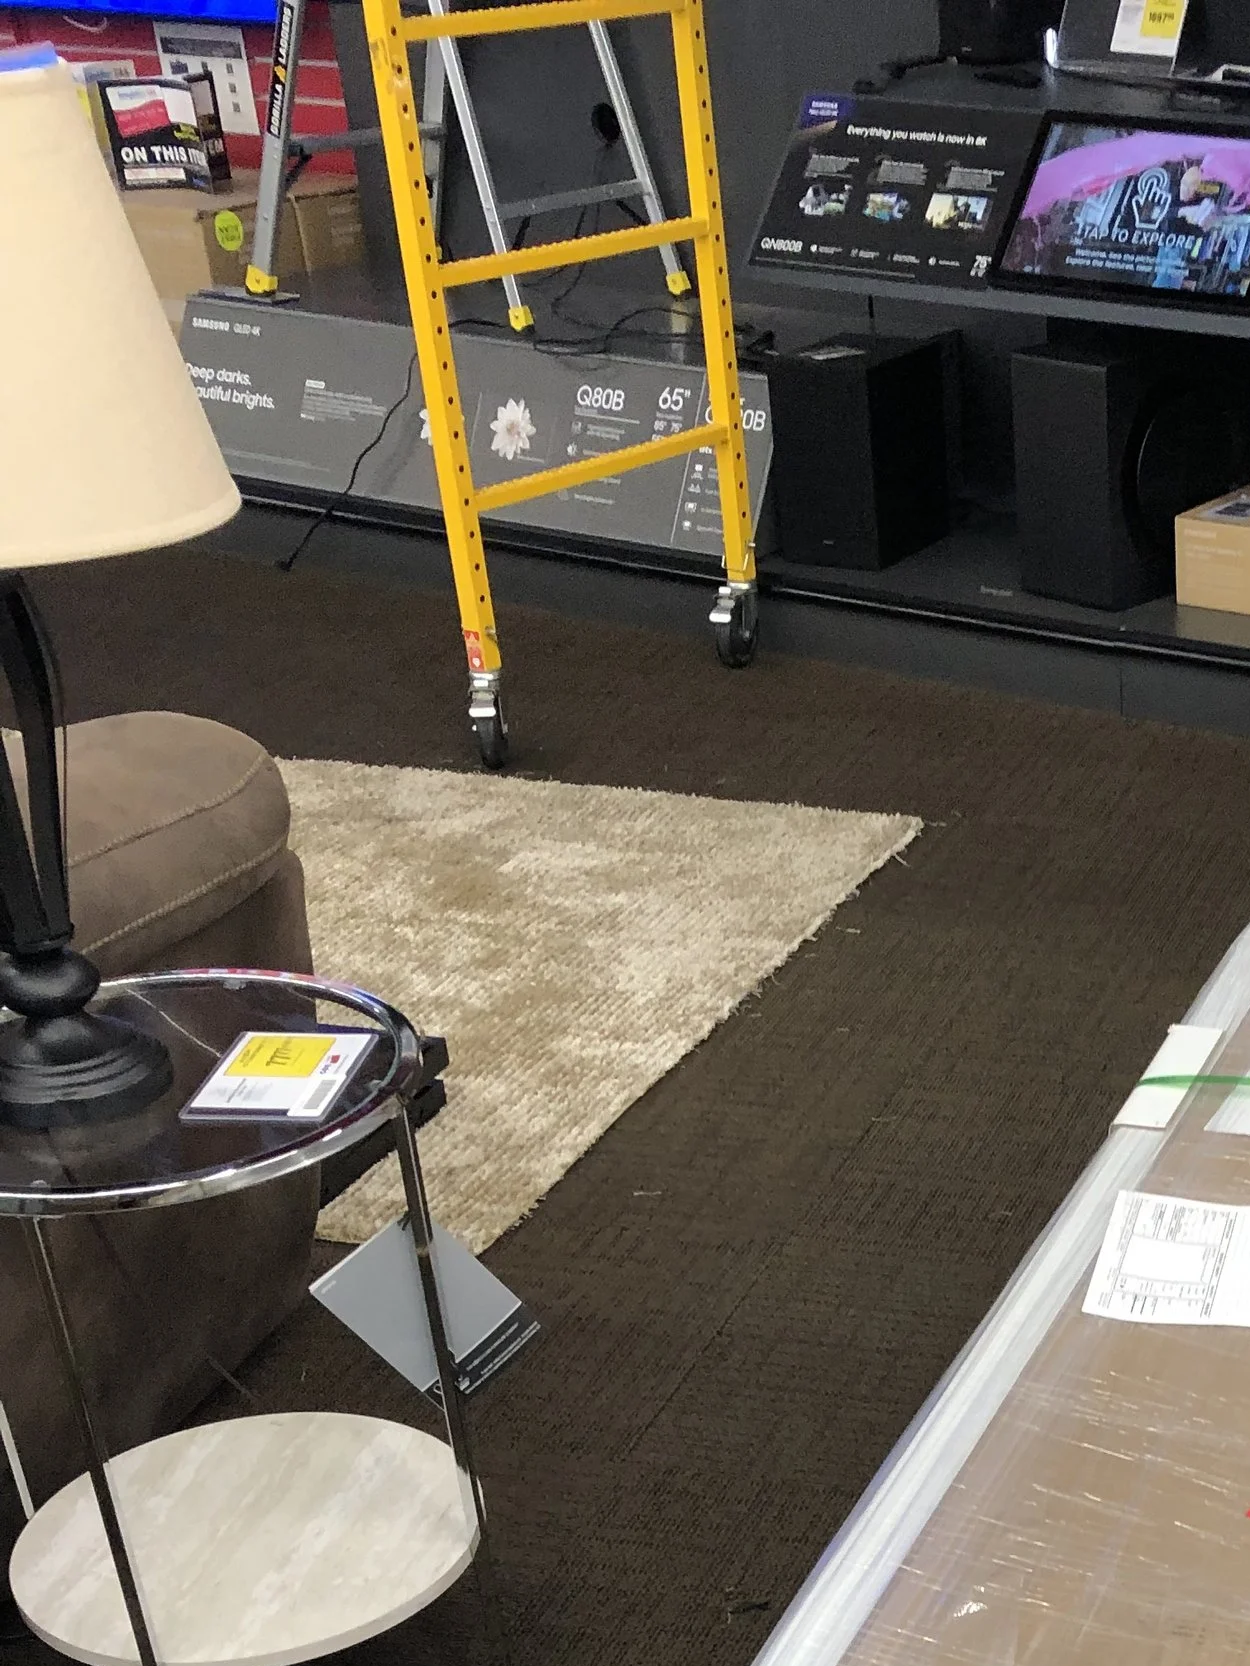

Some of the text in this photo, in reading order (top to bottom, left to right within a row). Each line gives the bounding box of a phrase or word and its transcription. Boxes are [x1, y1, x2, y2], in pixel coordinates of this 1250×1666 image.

[277, 6, 294, 65] LADDERS
[892, 130, 908, 140] you
[121, 146, 149, 164] ON
[150, 145, 187, 164] THIS
[1132, 229, 1196, 250] EXPLORE
[217, 368, 252, 386] darks.
[196, 385, 276, 410] autiful brights.
[576, 384, 692, 411] Q80B 65"
